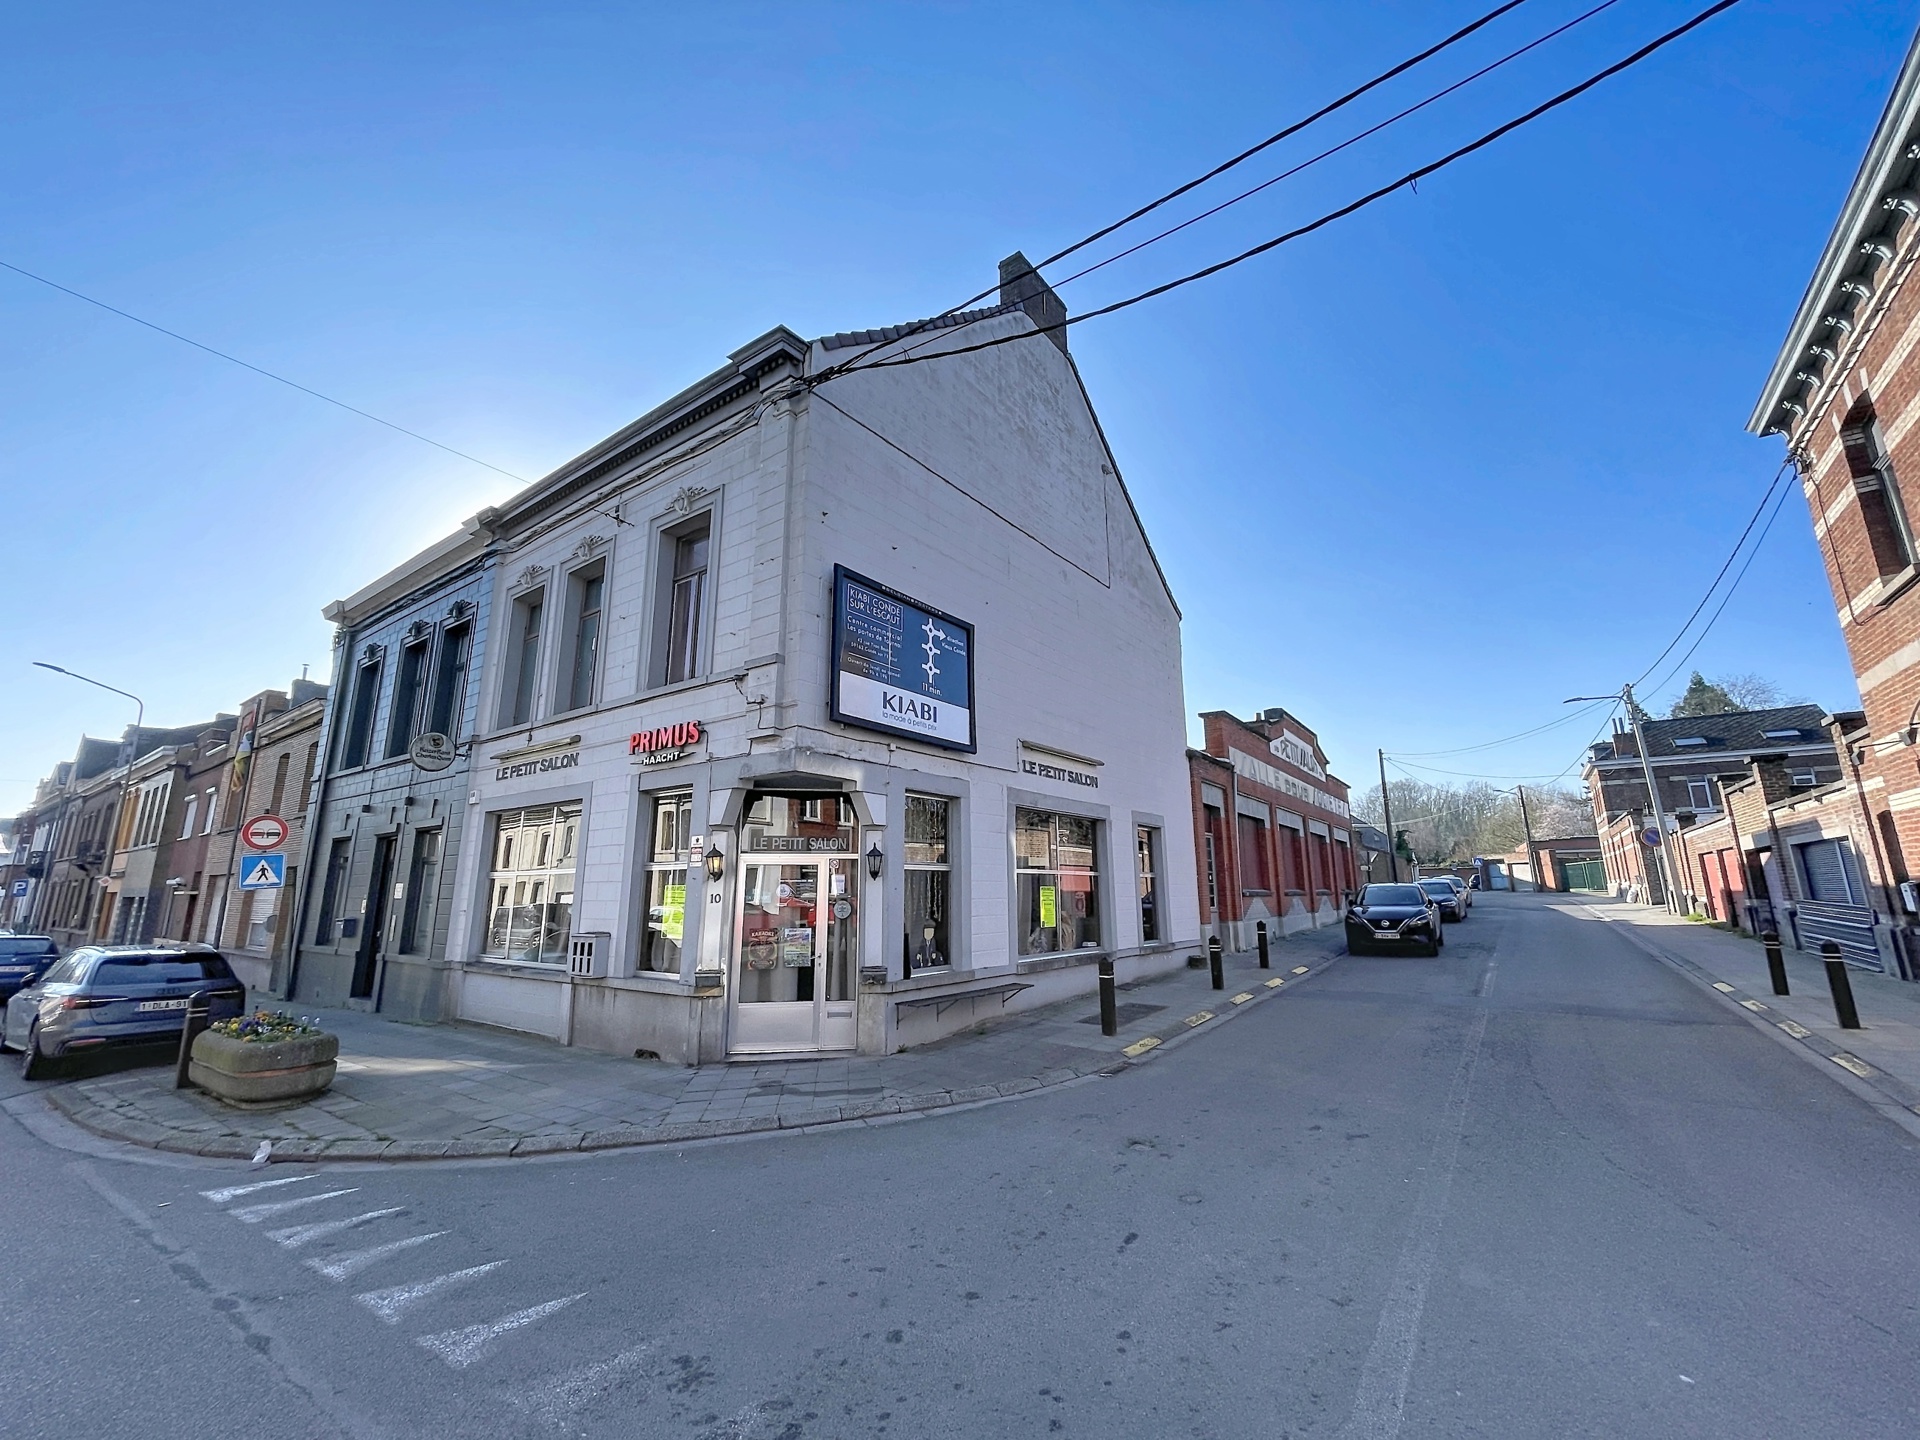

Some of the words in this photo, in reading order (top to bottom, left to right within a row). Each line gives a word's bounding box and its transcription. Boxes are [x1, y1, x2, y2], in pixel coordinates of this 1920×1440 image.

[850, 589, 870, 604] KIABI
[872, 599, 900, 617] CONDÉ
[850, 599, 865, 611] SUR
[866, 605, 900, 625] L'ESCAUT
[847, 616, 868, 628] Centre
[847, 623, 856, 631] Les
[883, 636, 903, 649] Tornai
[882, 691, 938, 723] KIABI
[882, 710, 888, 719] la
[628, 720, 700, 755] PRIMUS
[495, 767, 510, 781] LE
[509, 760, 539, 778] PETIT
[539, 752, 579, 772] SALON
[642, 751, 680, 766] HAACHT
[1022, 760, 1037, 775] LE
[1038, 763, 1066, 781] PETIT
[1068, 770, 1098, 788] SALON
[753, 838, 768, 850] LE
[772, 838, 805, 850] PETIT
[808, 838, 847, 850] SALON
[13, 882, 26, 894] P
[710, 893, 721, 904] 10
[142, 1001, 187, 1010] 1-DLA-91
